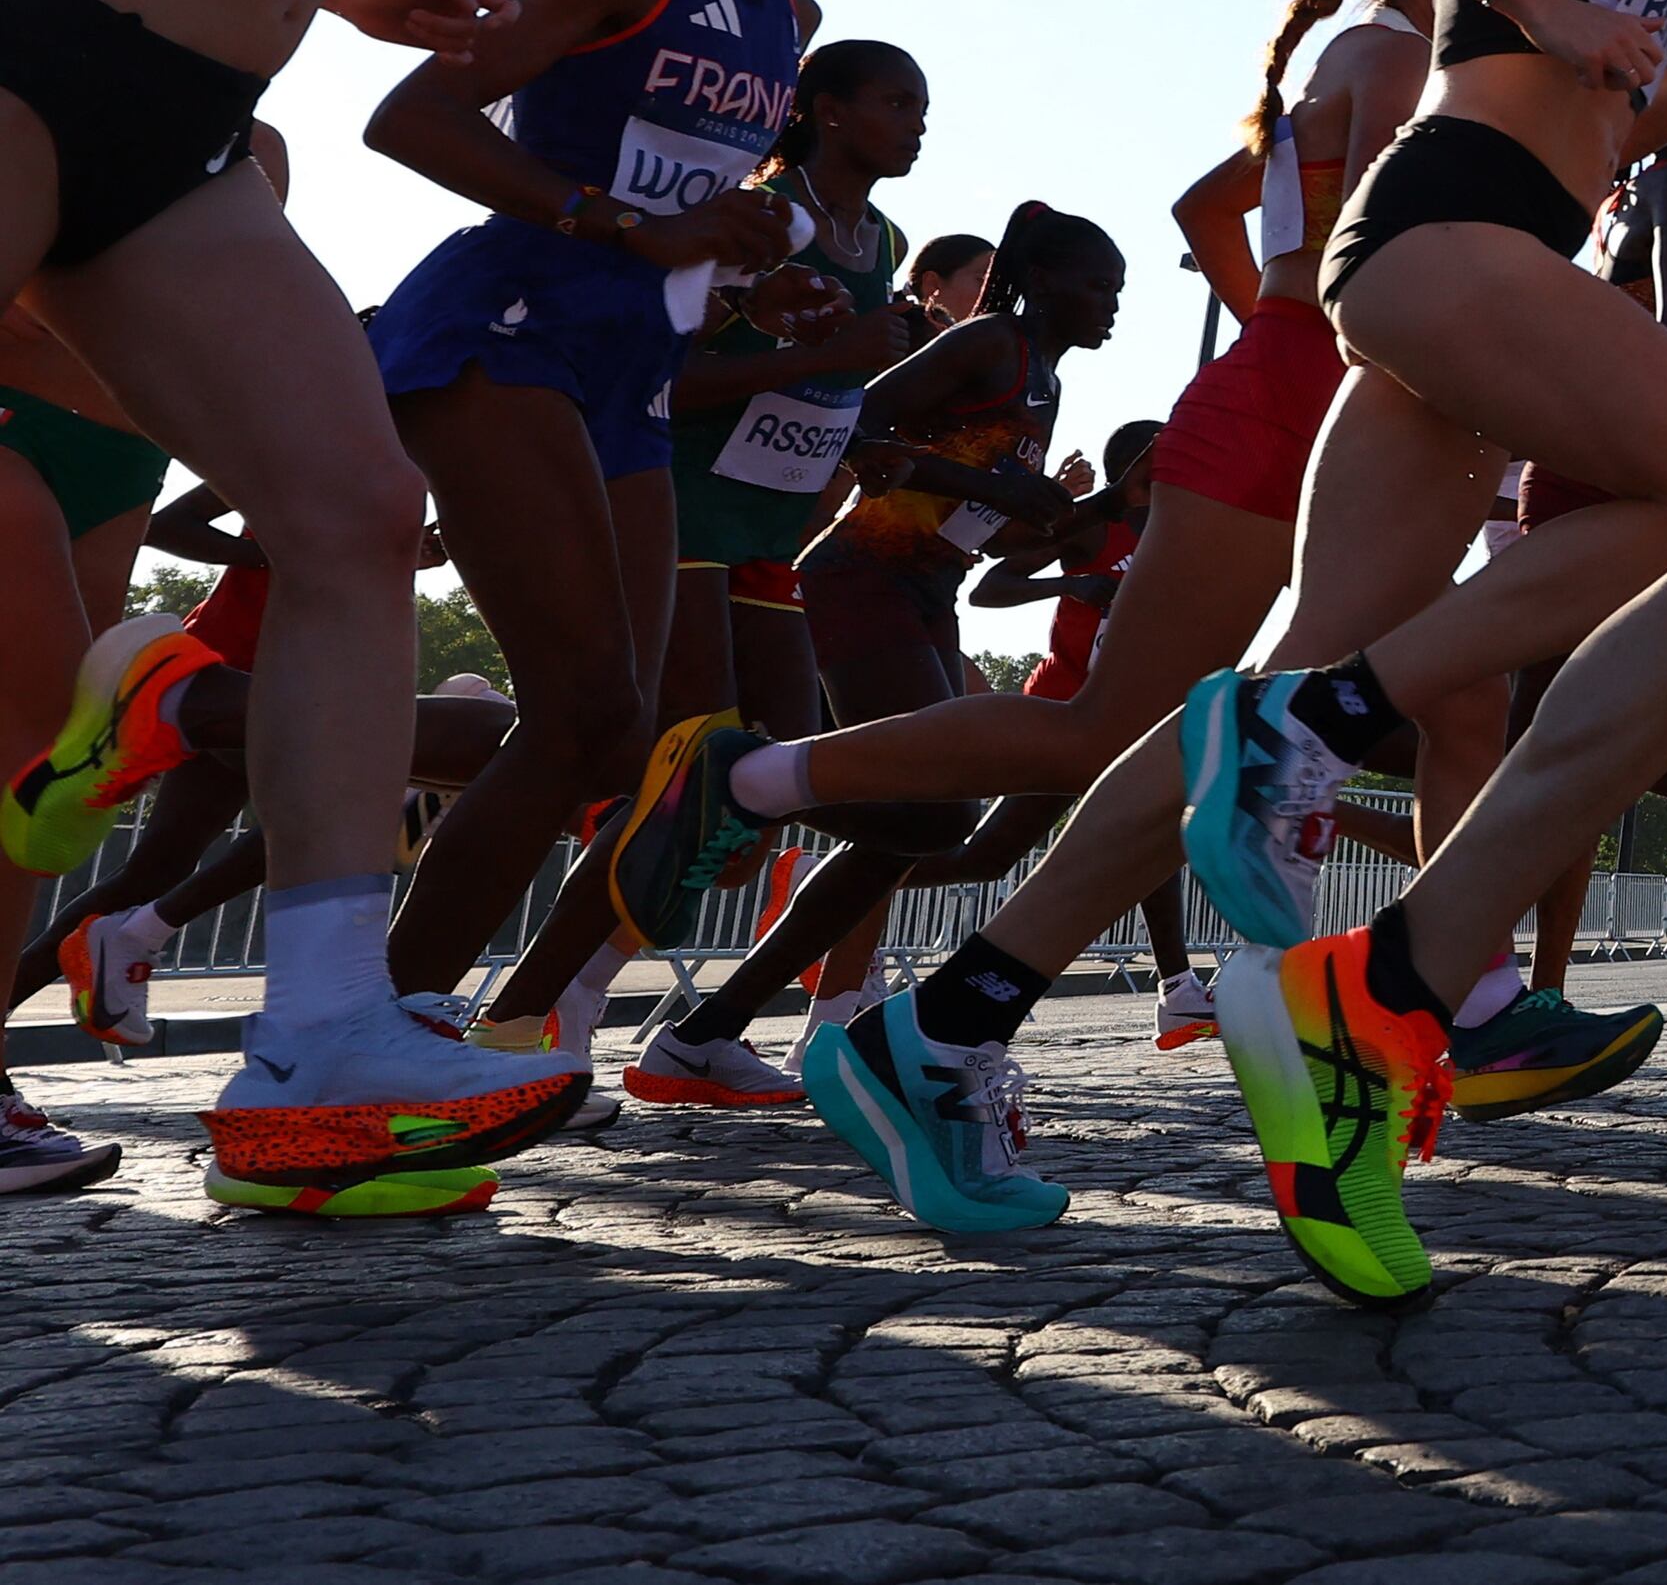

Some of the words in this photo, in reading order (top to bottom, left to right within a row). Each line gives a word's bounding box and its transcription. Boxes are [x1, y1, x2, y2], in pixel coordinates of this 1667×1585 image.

[695, 117, 738, 140] PARIS
[628, 148, 729, 212] WO
[744, 413, 849, 459] ASSEFA
